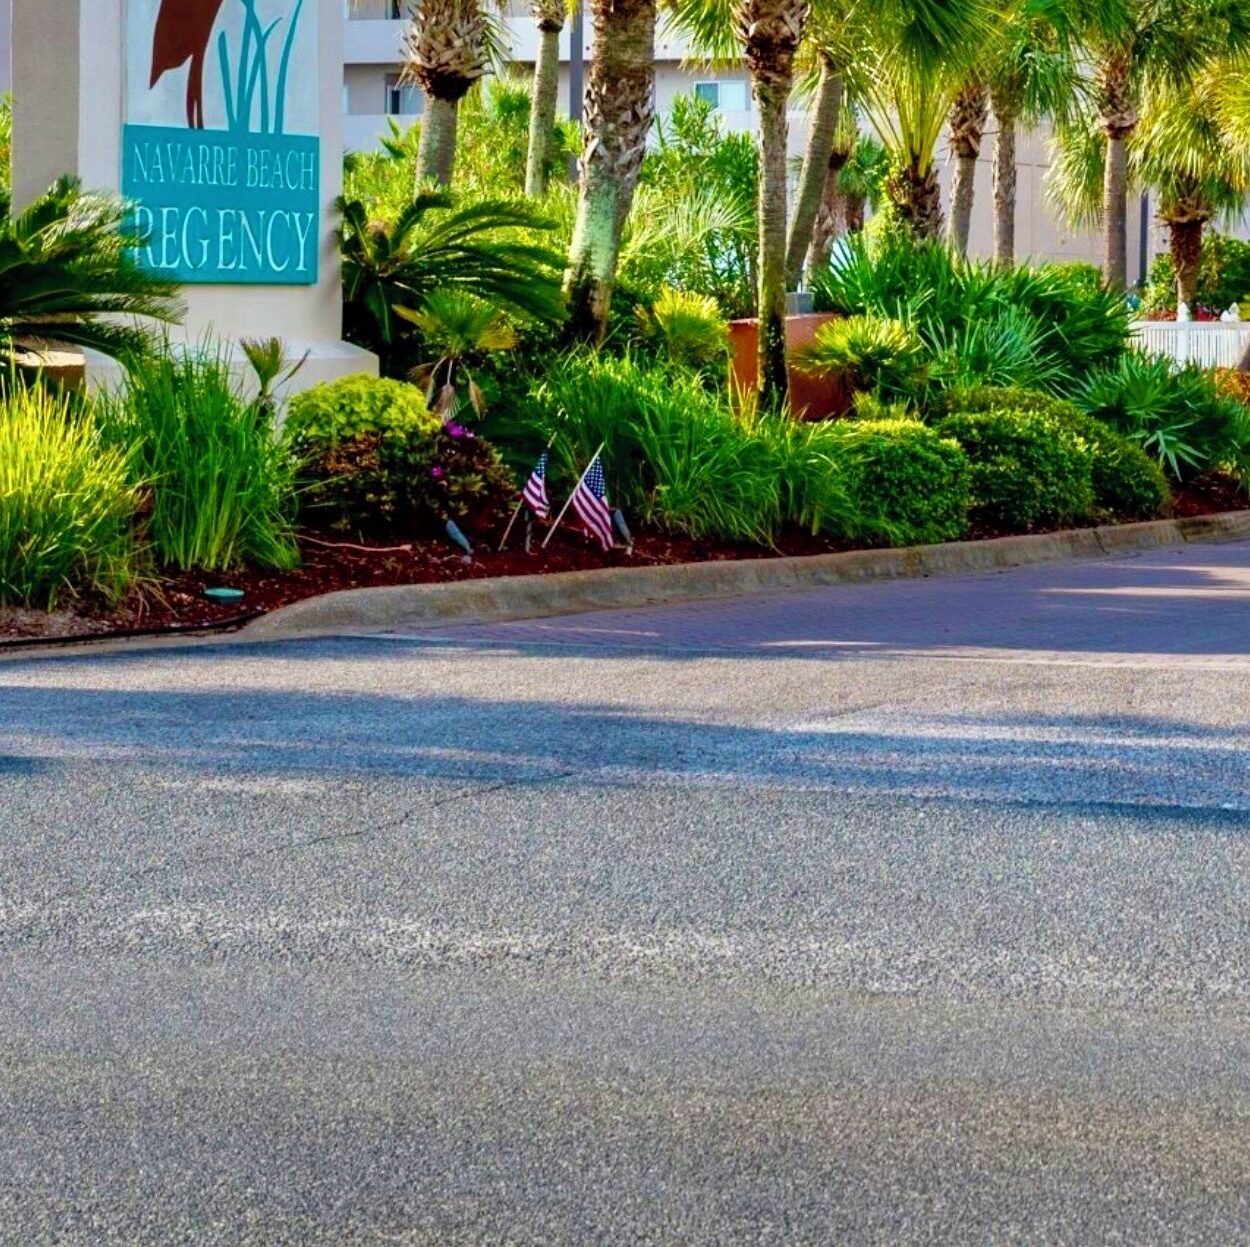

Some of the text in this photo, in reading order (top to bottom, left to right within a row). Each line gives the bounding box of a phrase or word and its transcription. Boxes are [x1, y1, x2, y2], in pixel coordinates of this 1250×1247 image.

[133, 142, 315, 191] NAVARRE BEACH
[134, 205, 315, 273] REGENCY
